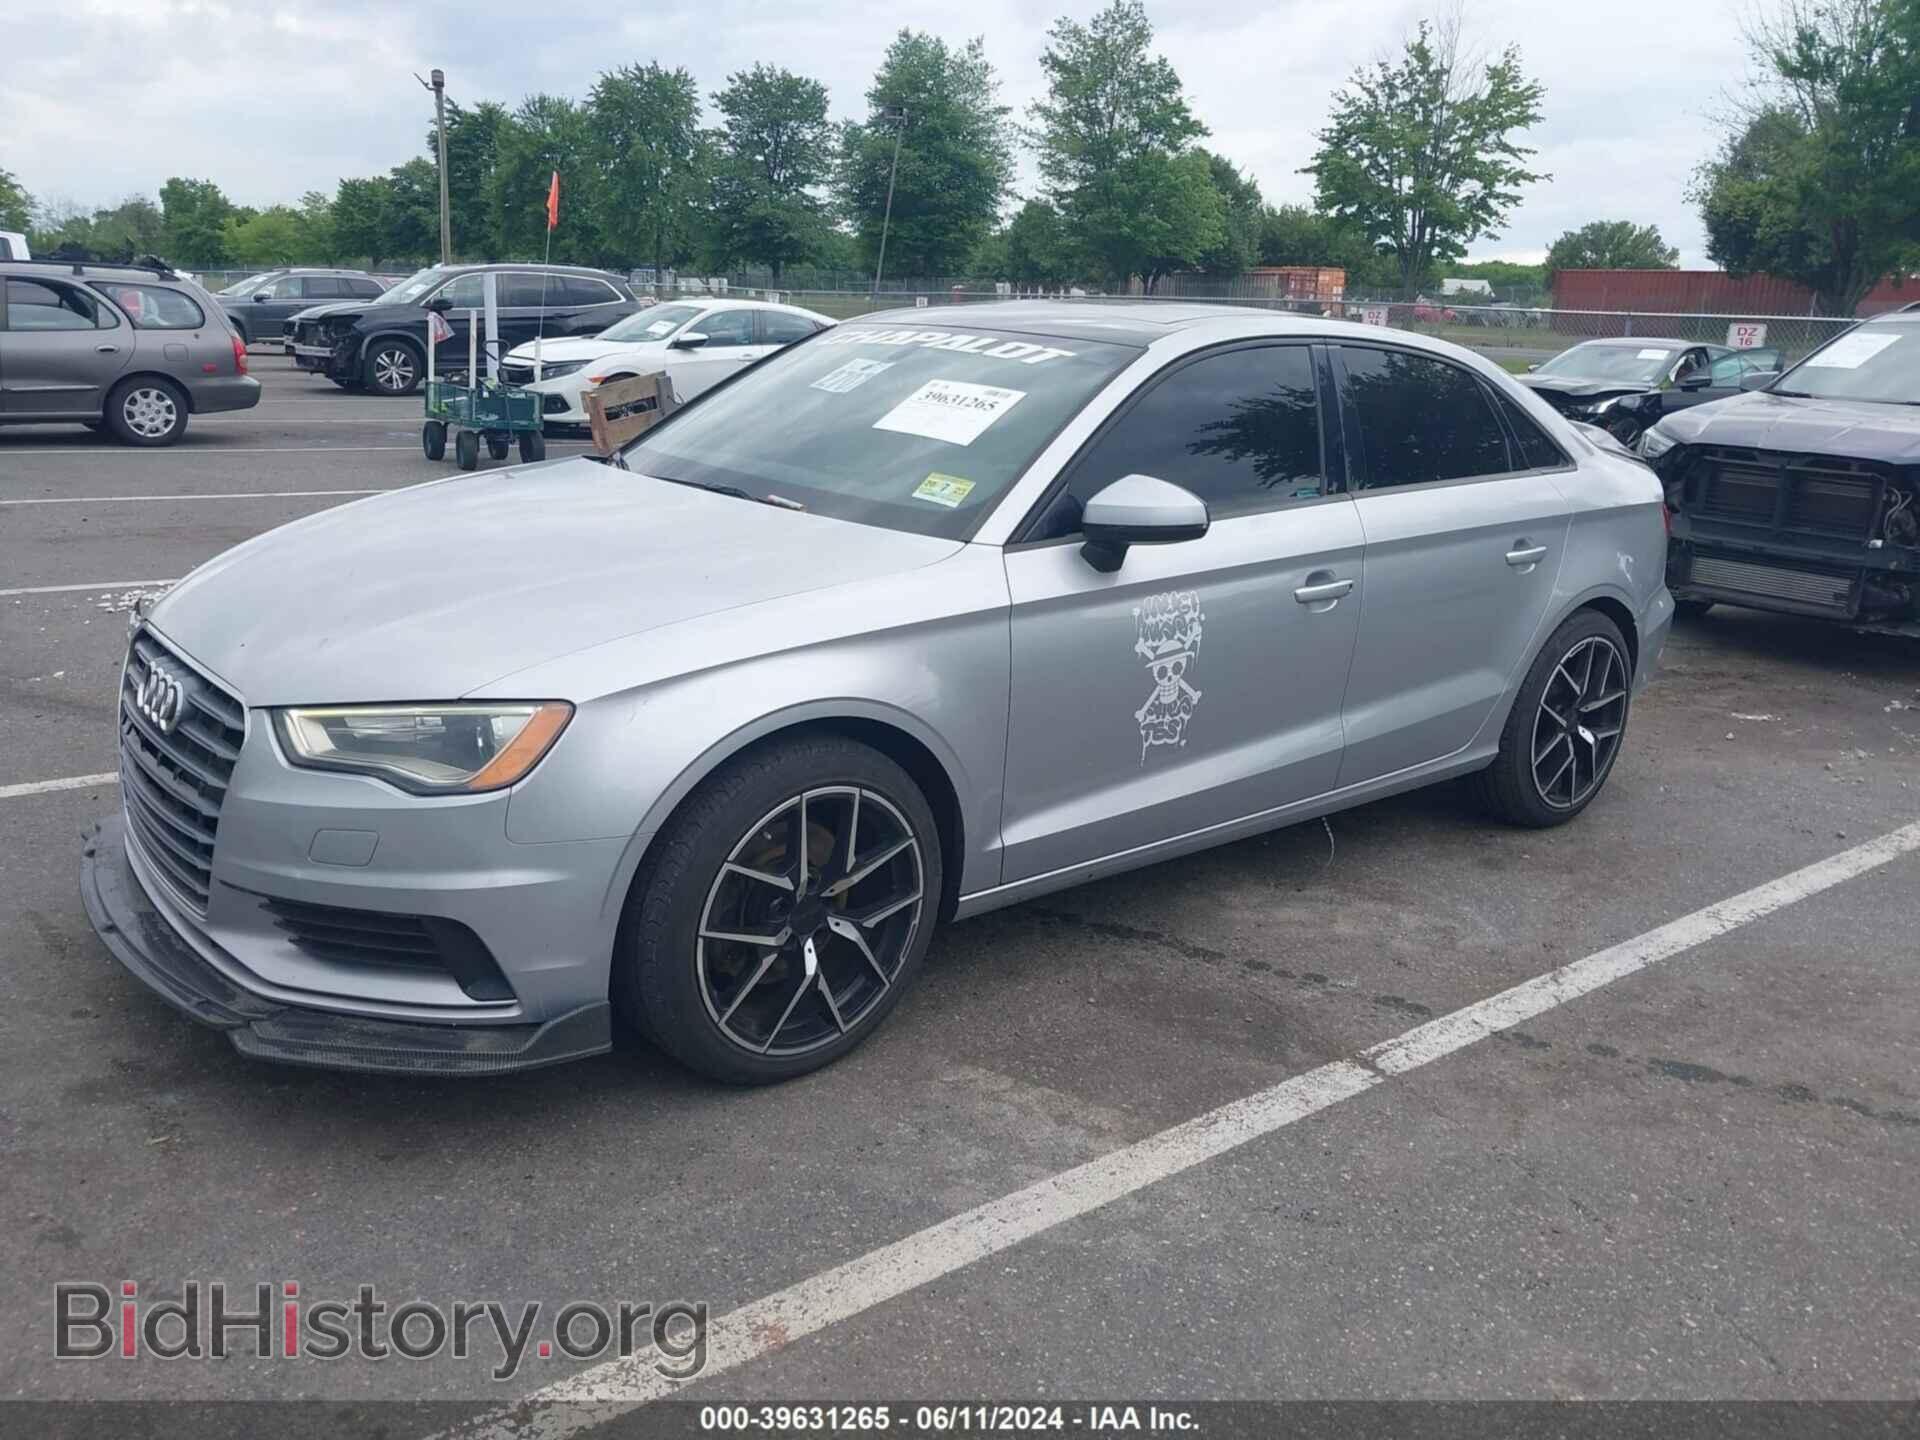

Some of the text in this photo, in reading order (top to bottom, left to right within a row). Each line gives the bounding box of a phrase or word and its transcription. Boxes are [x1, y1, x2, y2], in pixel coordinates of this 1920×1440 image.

[1737, 327, 1758, 337] DZ
[1739, 337, 1753, 346] 16
[917, 391, 1000, 411] 39631265
